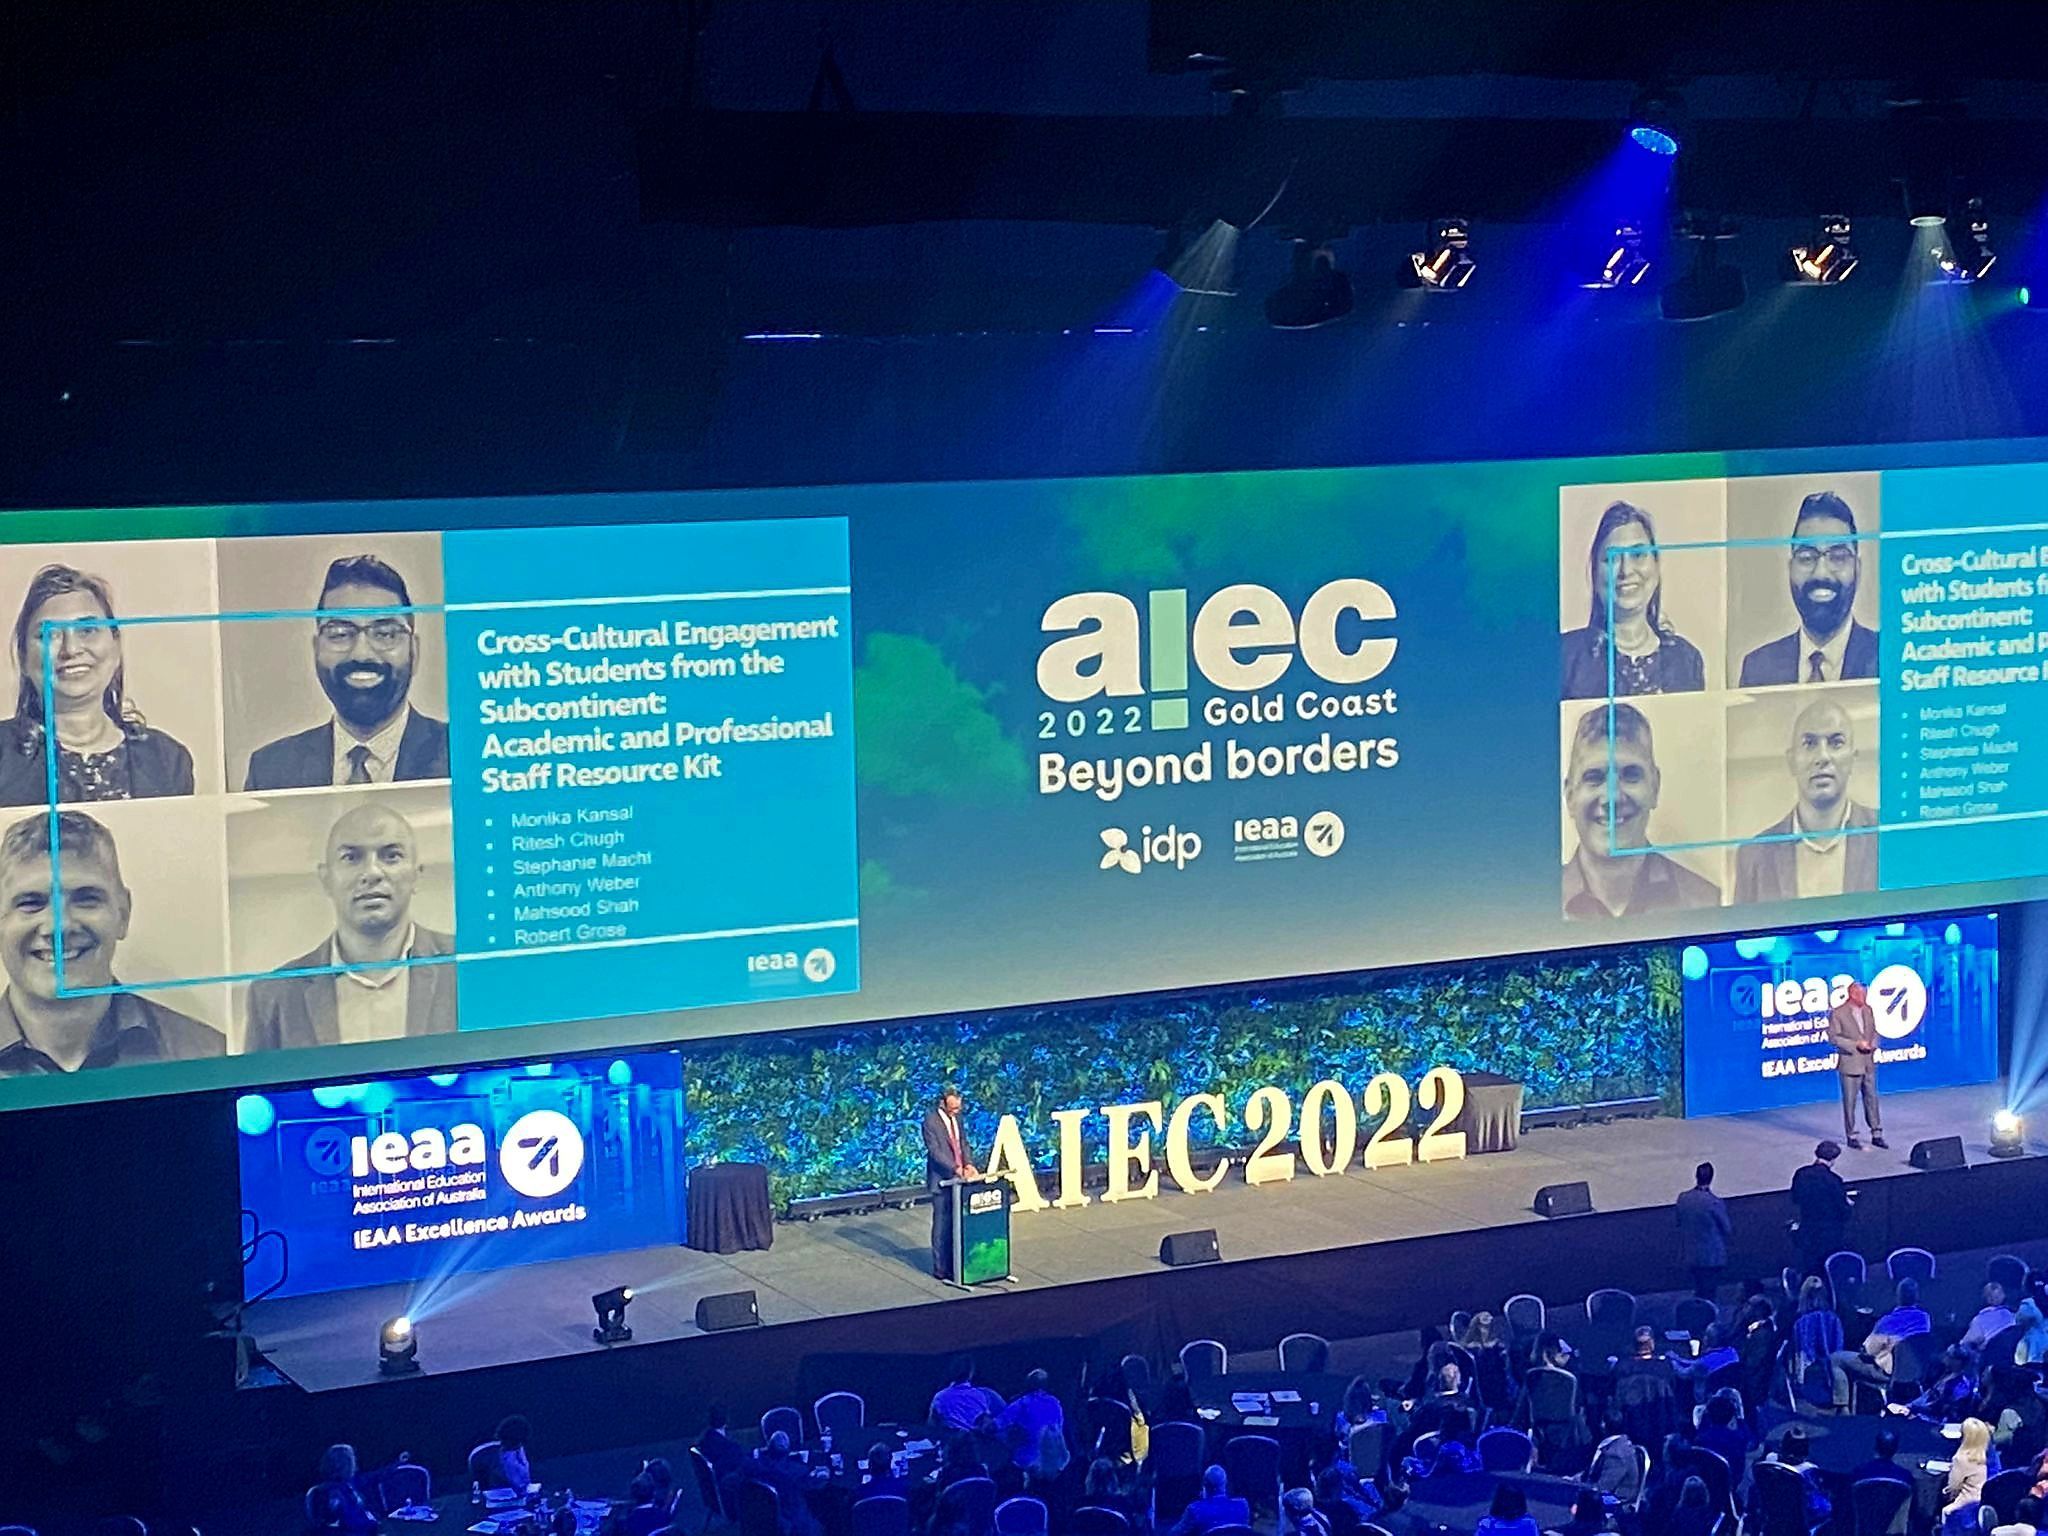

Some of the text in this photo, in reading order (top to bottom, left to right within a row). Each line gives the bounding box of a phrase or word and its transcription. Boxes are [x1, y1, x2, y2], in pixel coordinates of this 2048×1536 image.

[1901, 545, 2036, 575] Cross-Cultural
[1901, 579, 1945, 604] with
[1948, 577, 2034, 601] Students
[477, 615, 839, 656] Cross-Cultural Engagement
[1901, 635, 1995, 663] Academic
[1998, 632, 2034, 655] and
[478, 649, 784, 689] with Students from the
[1901, 664, 1950, 691] Staff
[1952, 665, 2039, 687] Resource
[479, 693, 667, 725] Subcontinent:
[1038, 688, 1398, 738] 2022 Gold Coast
[482, 712, 833, 759] Academic and Professional
[481, 753, 722, 793] Staff Resource Kit
[1039, 733, 1399, 801] Beyond borders
[511, 805, 633, 829] Monika Kansal
[512, 830, 625, 852] Ritesh Chugh
[1142, 824, 1202, 870] idp
[513, 856, 596, 877] Stephanie
[513, 875, 640, 899] Anthony Weber
[514, 898, 639, 922] Mahsood Shah
[515, 923, 626, 945] Robert Grose
[1797, 1053, 1839, 1073] Excell
[353, 1171, 486, 1198] International Education
[353, 1188, 486, 1215] Association of Australia
[353, 1202, 586, 1250] IEAA Excellence Awards
